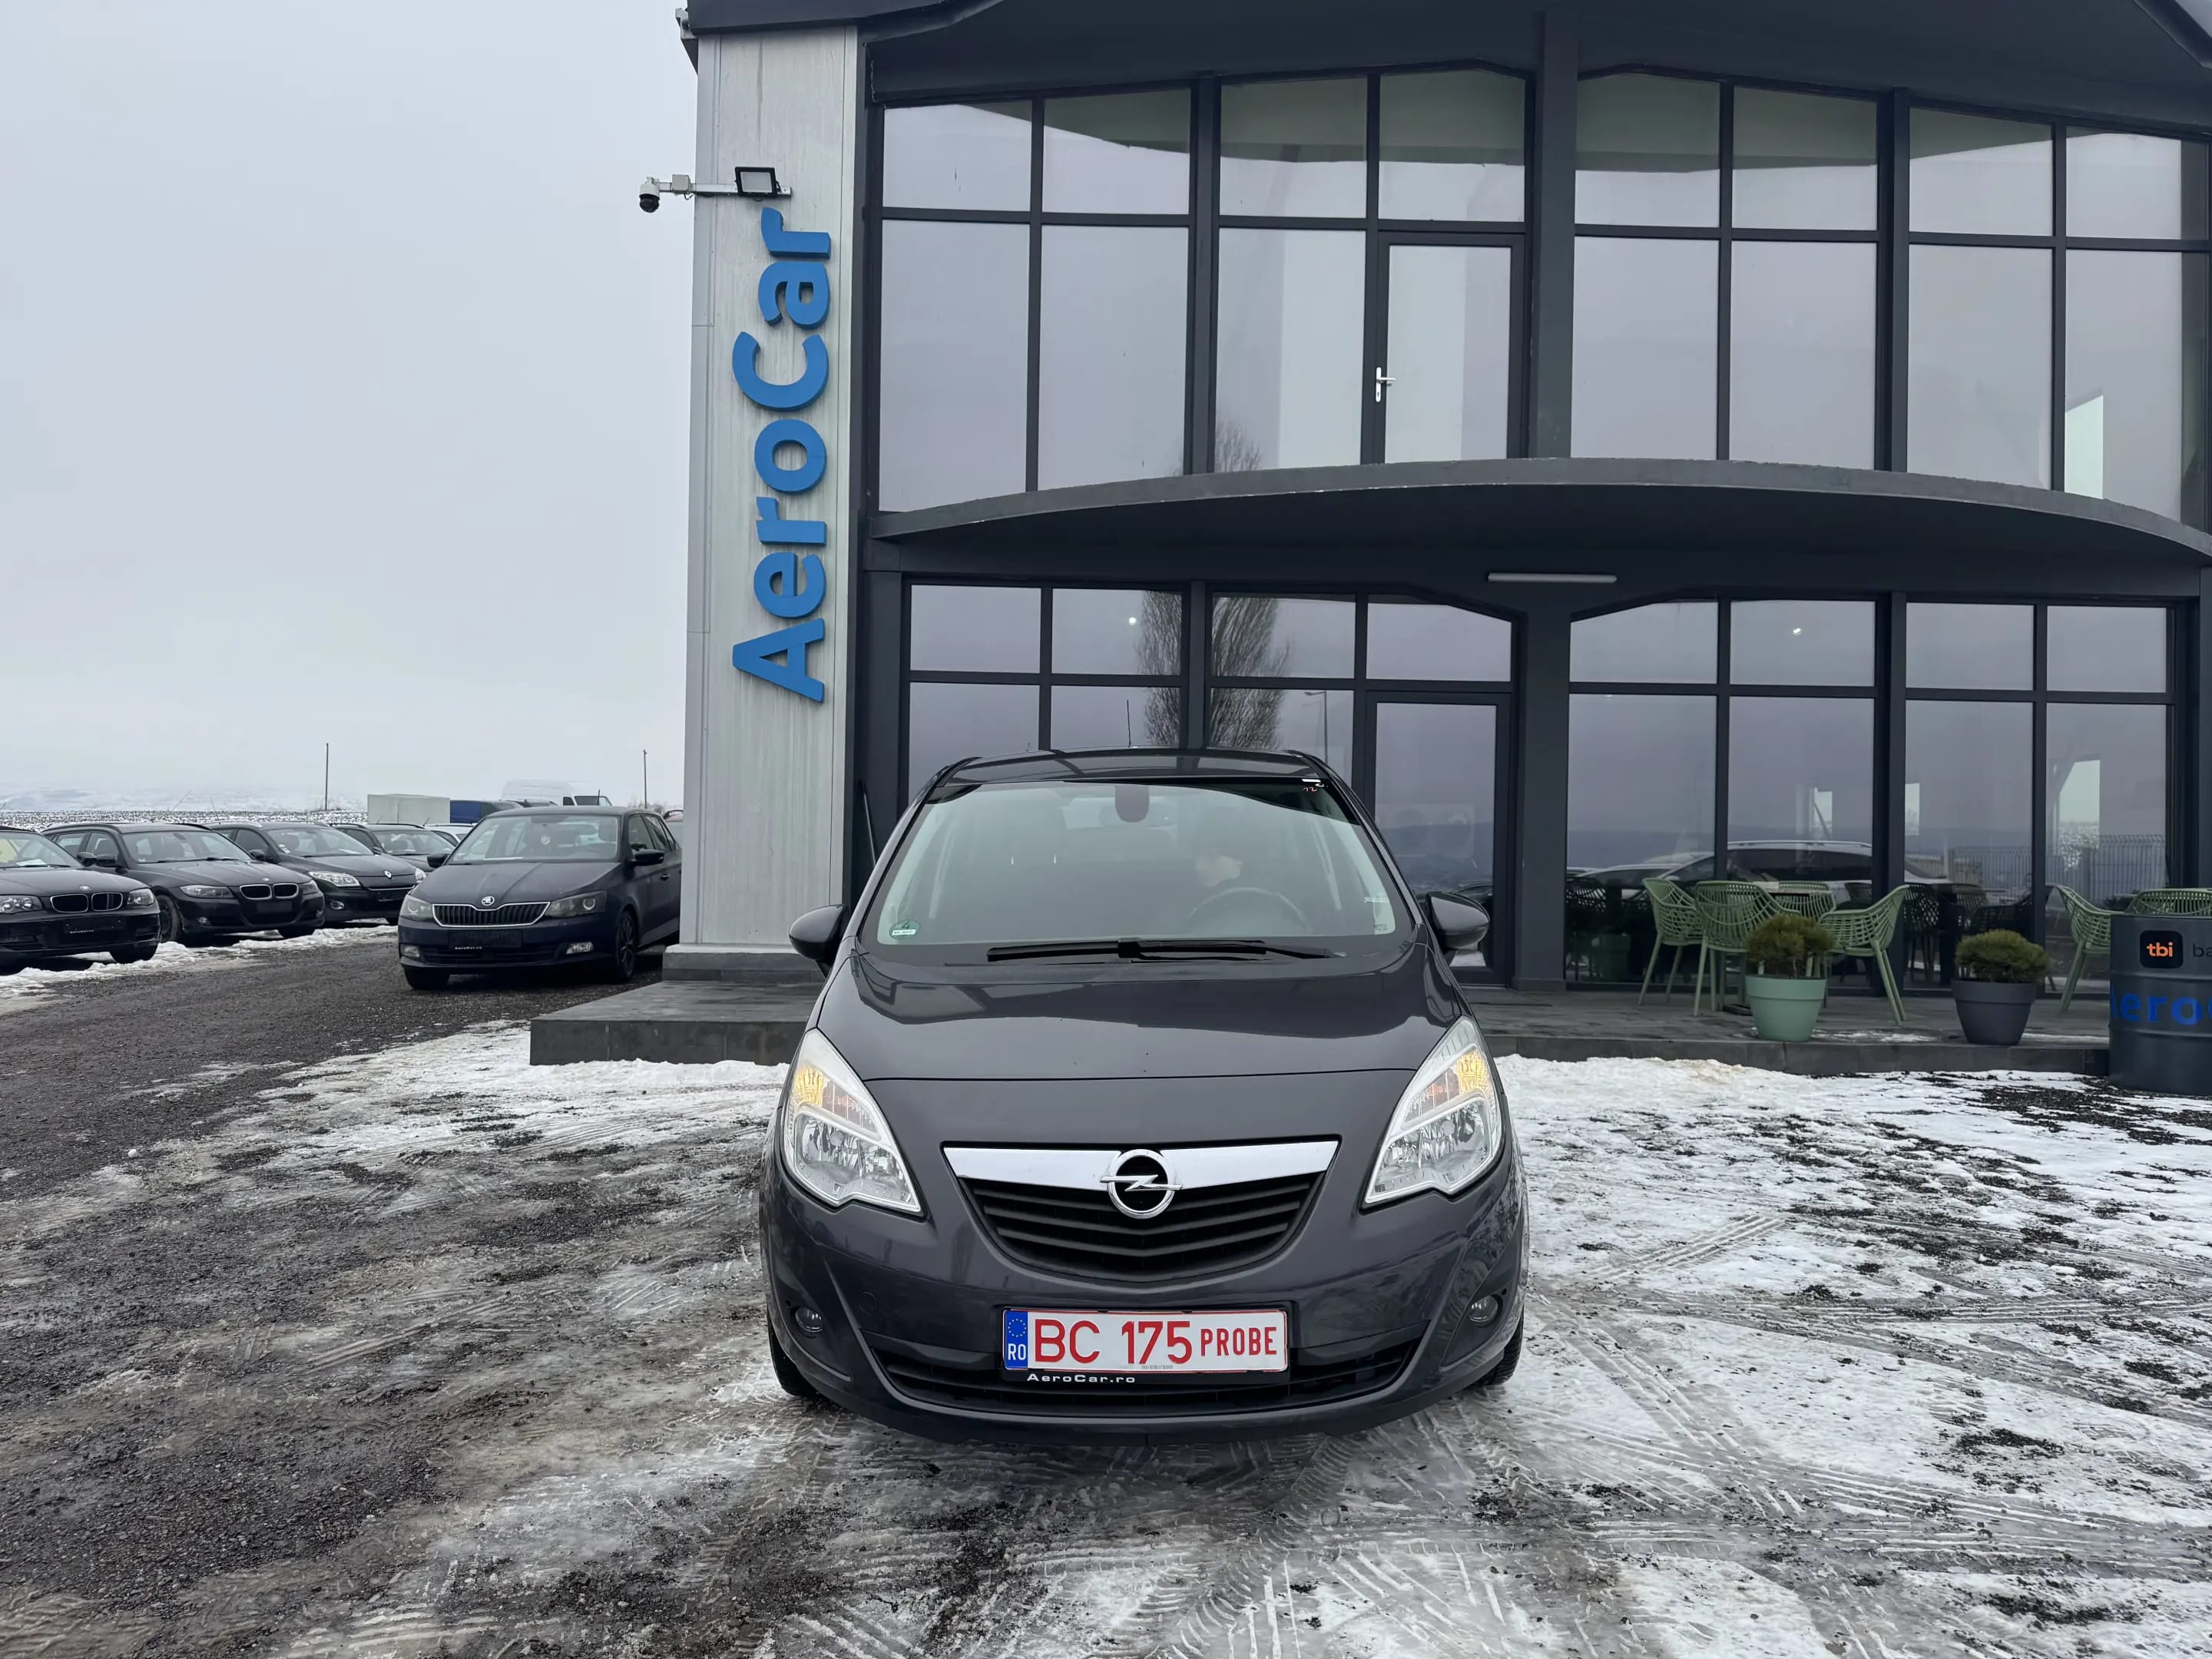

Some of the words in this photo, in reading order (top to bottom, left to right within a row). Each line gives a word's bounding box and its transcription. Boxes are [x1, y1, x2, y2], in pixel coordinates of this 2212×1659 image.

[732, 207, 831, 703] AeroCar
[2146, 942, 2174, 958] tbi
[2110, 982, 2212, 1025] ero
[1008, 1343, 1027, 1361] RO
[1035, 1319, 1100, 1364] BC
[1121, 1320, 1193, 1365] 175
[1200, 1326, 1277, 1356] PROBE
[1027, 1373, 1136, 1383] AeroCar.ro
